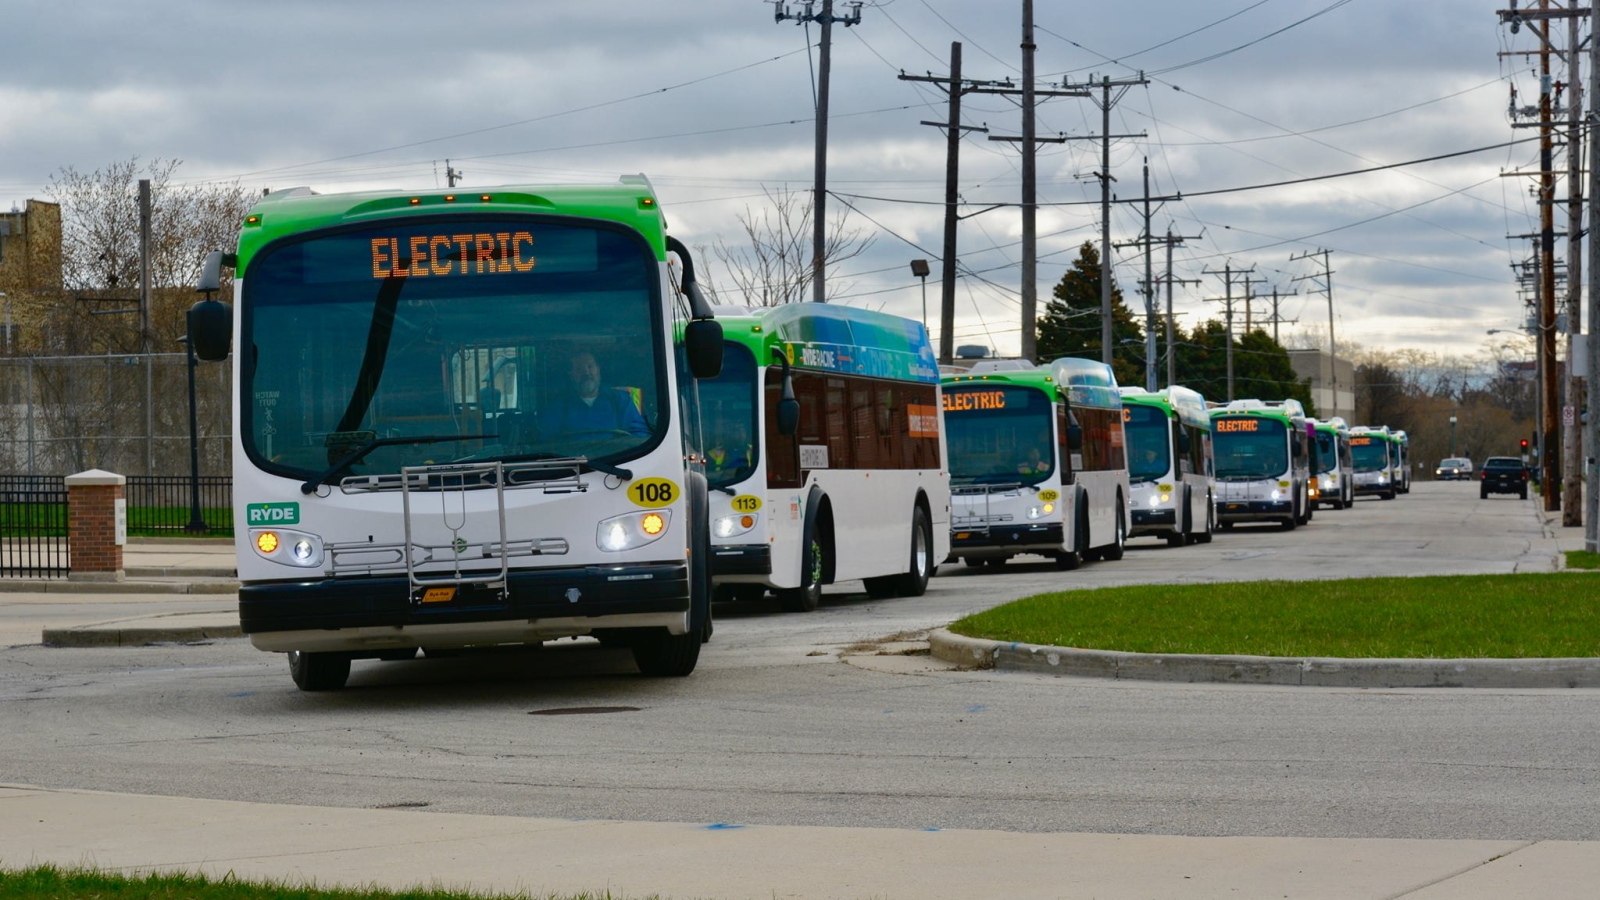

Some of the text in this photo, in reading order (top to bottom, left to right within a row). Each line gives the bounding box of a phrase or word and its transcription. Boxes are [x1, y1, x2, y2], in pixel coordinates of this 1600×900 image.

[371, 231, 535, 278] ELECTRIC
[941, 391, 1005, 411] ELECTRIC
[1217, 420, 1258, 432] ELECTRIC
[1349, 437, 1370, 446] LECTRIC
[635, 483, 672, 502] 108
[1041, 491, 1056, 500] 109
[736, 498, 757, 510] 113
[250, 507, 295, 521] RYDE
